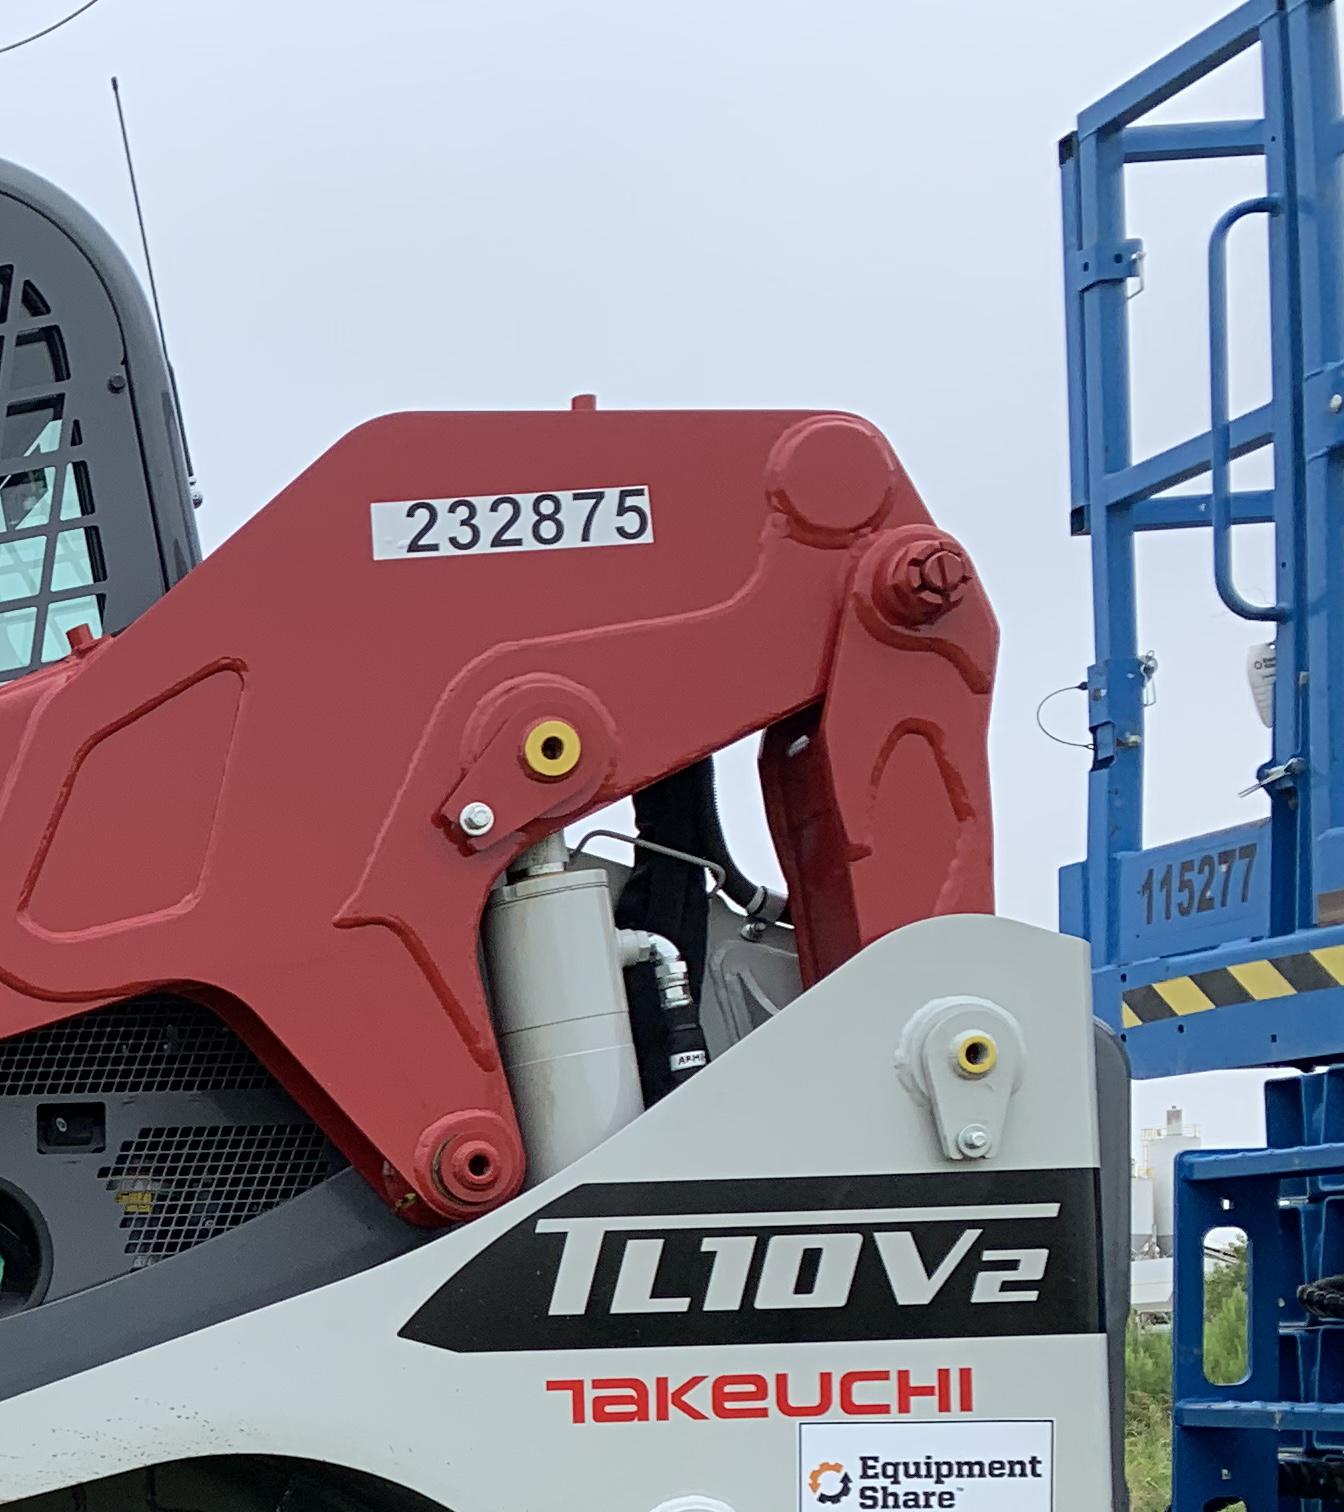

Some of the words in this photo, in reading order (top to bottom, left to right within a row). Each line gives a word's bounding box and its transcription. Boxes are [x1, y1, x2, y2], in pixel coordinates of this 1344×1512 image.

[406, 488, 648, 553] 232875
[1140, 843, 1258, 924] 115277
[535, 1203, 1061, 1316] TL10V2
[859, 1455, 1042, 1485] Equipment
[859, 1486, 956, 1510] Share
